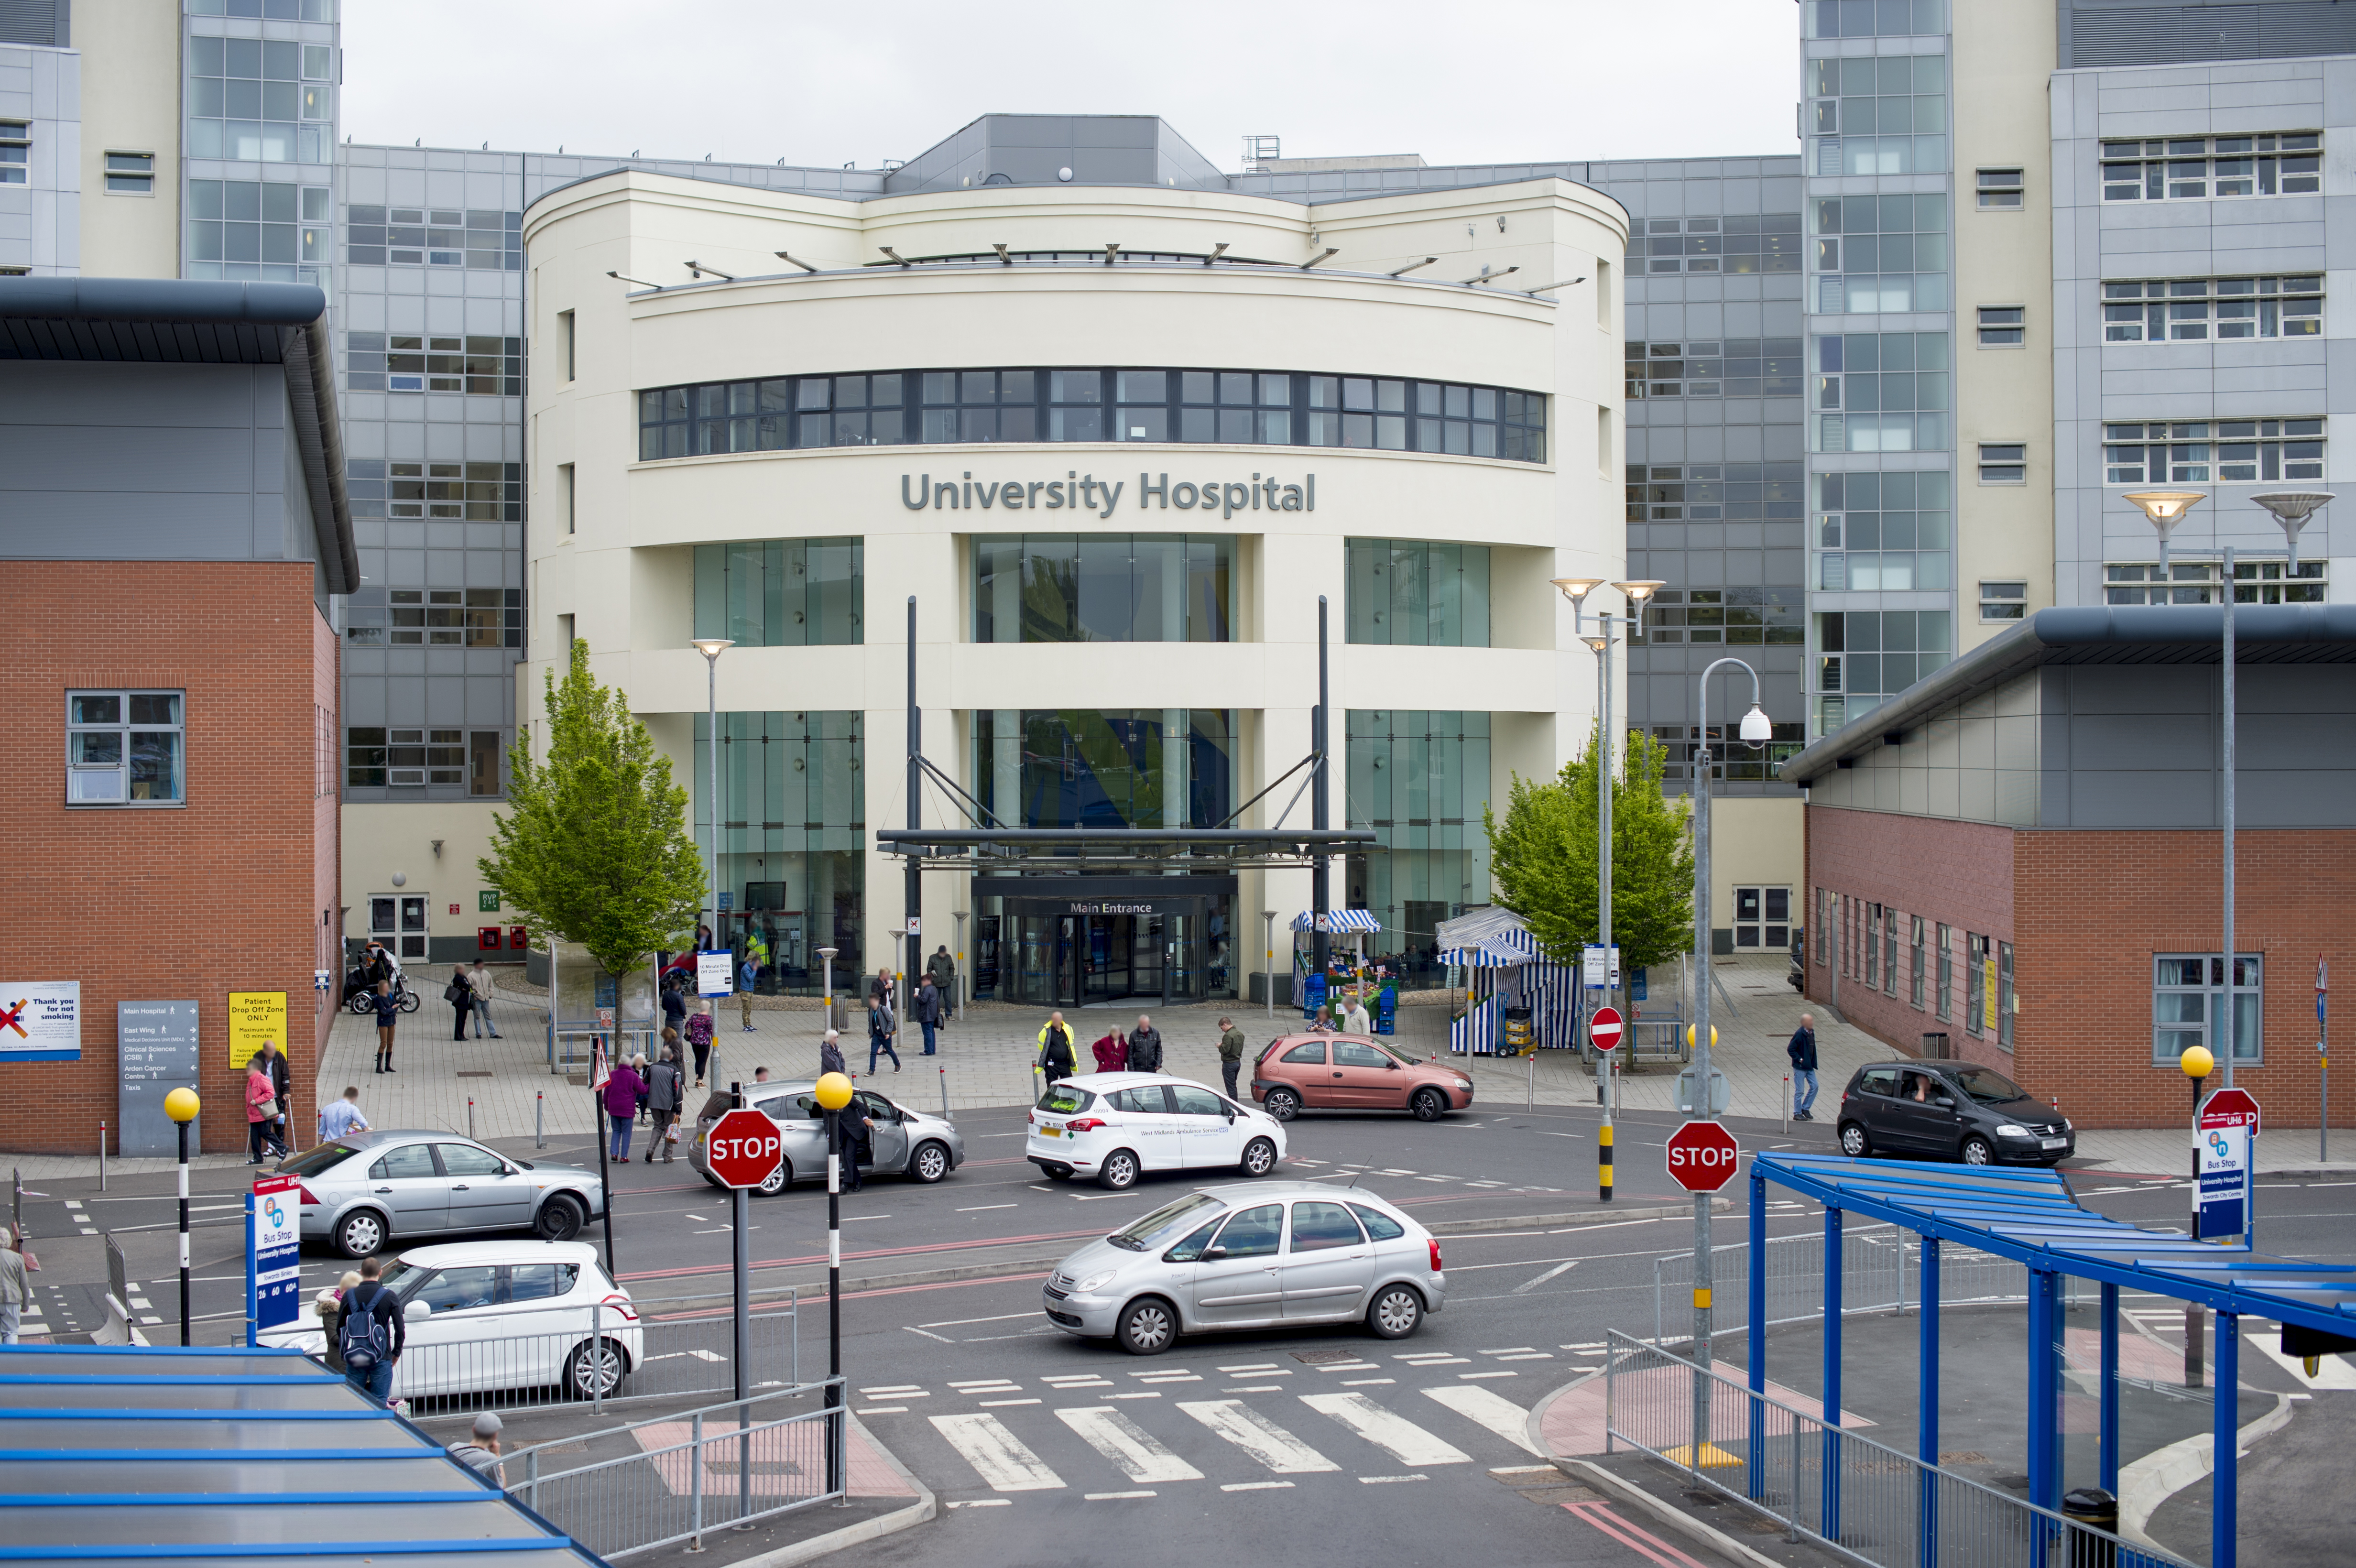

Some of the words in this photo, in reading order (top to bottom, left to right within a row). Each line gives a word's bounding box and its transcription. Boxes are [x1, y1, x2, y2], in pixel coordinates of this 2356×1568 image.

[901, 470, 1124, 519] University
[1141, 472, 1315, 519] Hospital
[1071, 903, 1099, 913] Main
[1102, 903, 1152, 913] Entrance
[2227, 1115, 2242, 1125] UH6
[712, 1137, 779, 1160] STOP
[1671, 1147, 1734, 1166] STOP
[2208, 1161, 2220, 1169] Bus
[2221, 1159, 2236, 1168] Stop
[2201, 1177, 2223, 1186] University
[2223, 1174, 2242, 1184] Hospital
[2202, 1205, 2207, 1213] 4
[264, 1234, 275, 1243] Bus
[277, 1231, 292, 1241] Stop
[257, 1249, 279, 1260] University
[279, 1244, 298, 1255] Hospital
[263, 1273, 280, 1281] Towards
[258, 1289, 266, 1299] 26
[272, 1285, 280, 1296] 60
